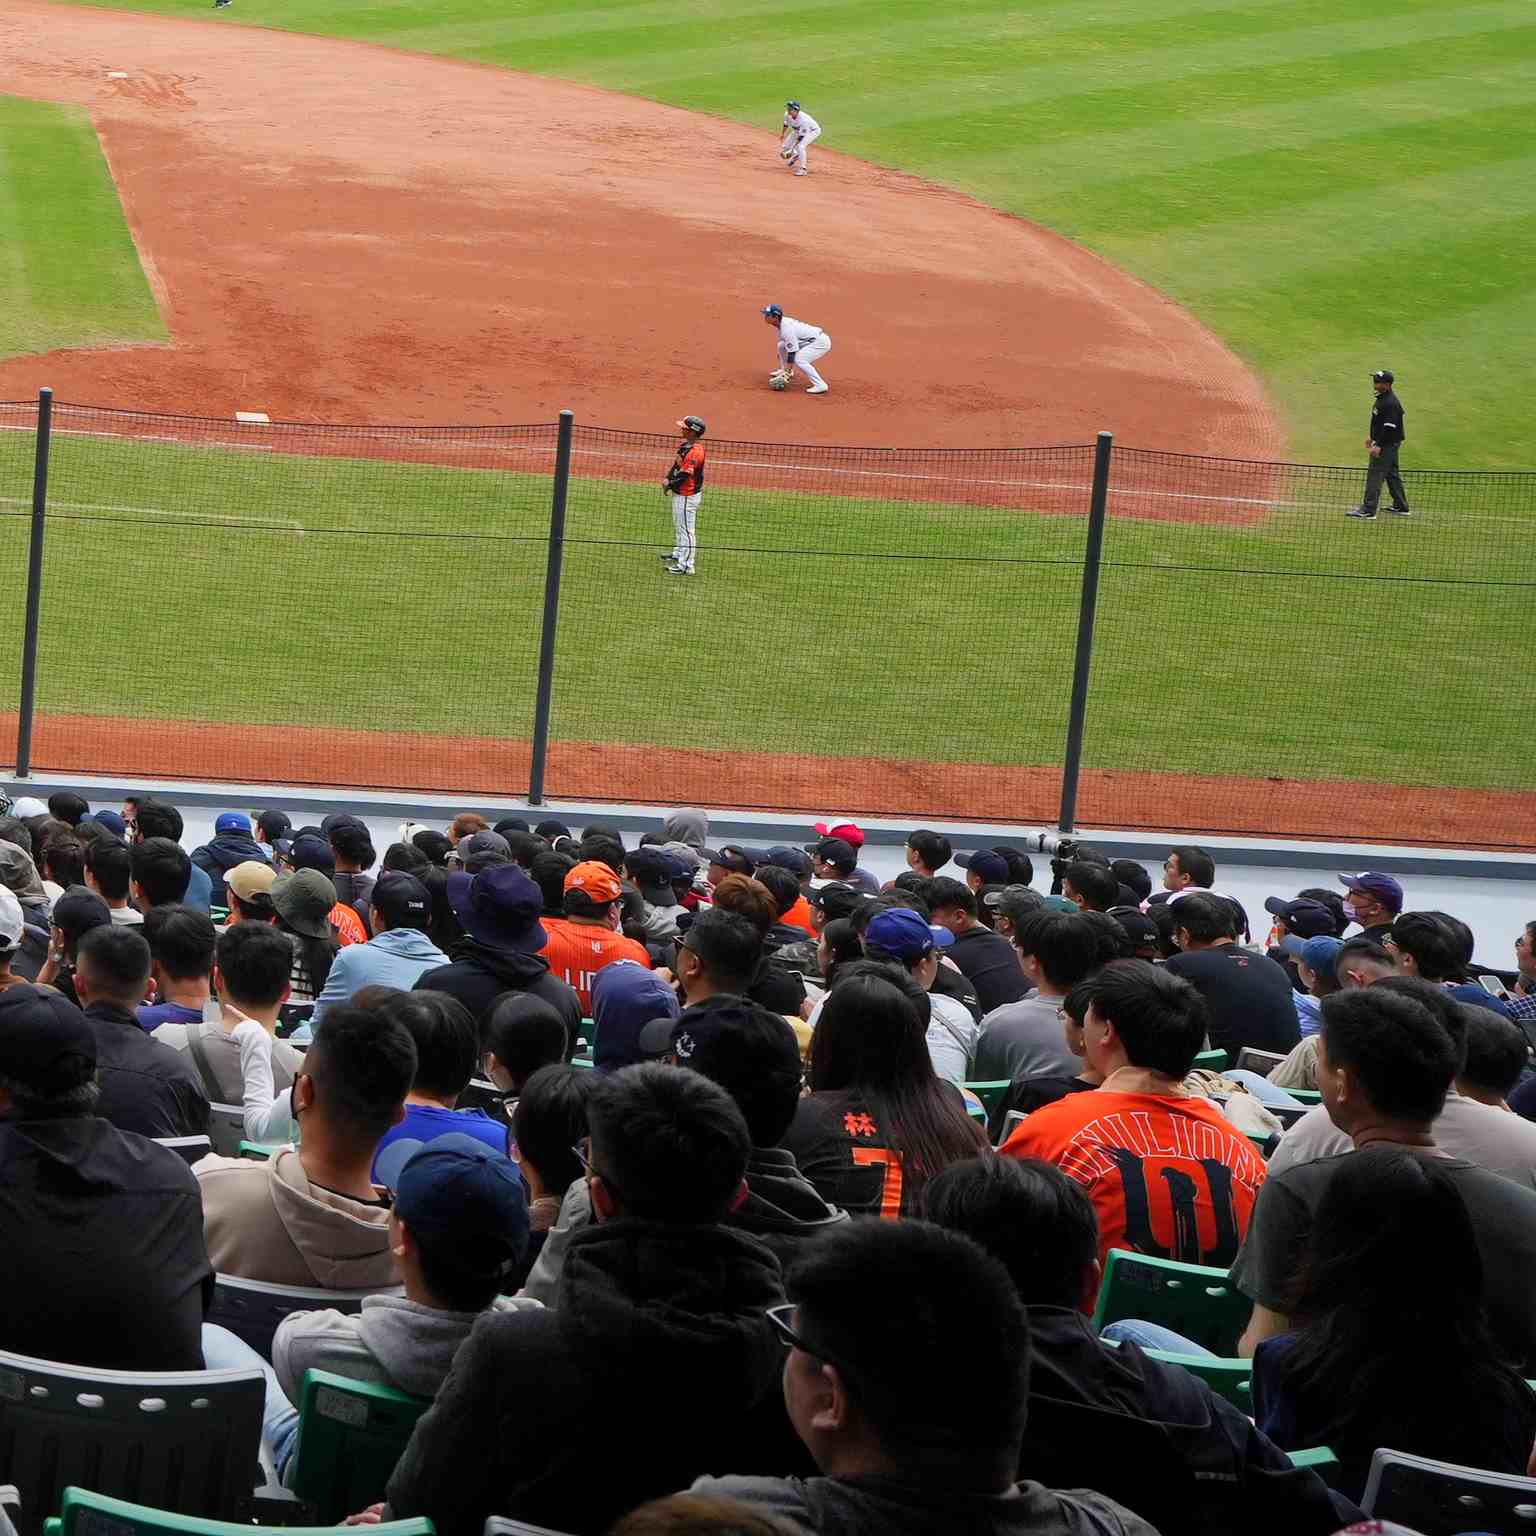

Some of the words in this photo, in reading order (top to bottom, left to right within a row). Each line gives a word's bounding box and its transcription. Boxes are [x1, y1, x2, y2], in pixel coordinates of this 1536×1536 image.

[843, 1111, 877, 1137] 林
[1057, 1111, 1268, 1195] UNILION
[851, 1146, 904, 1221] 7
